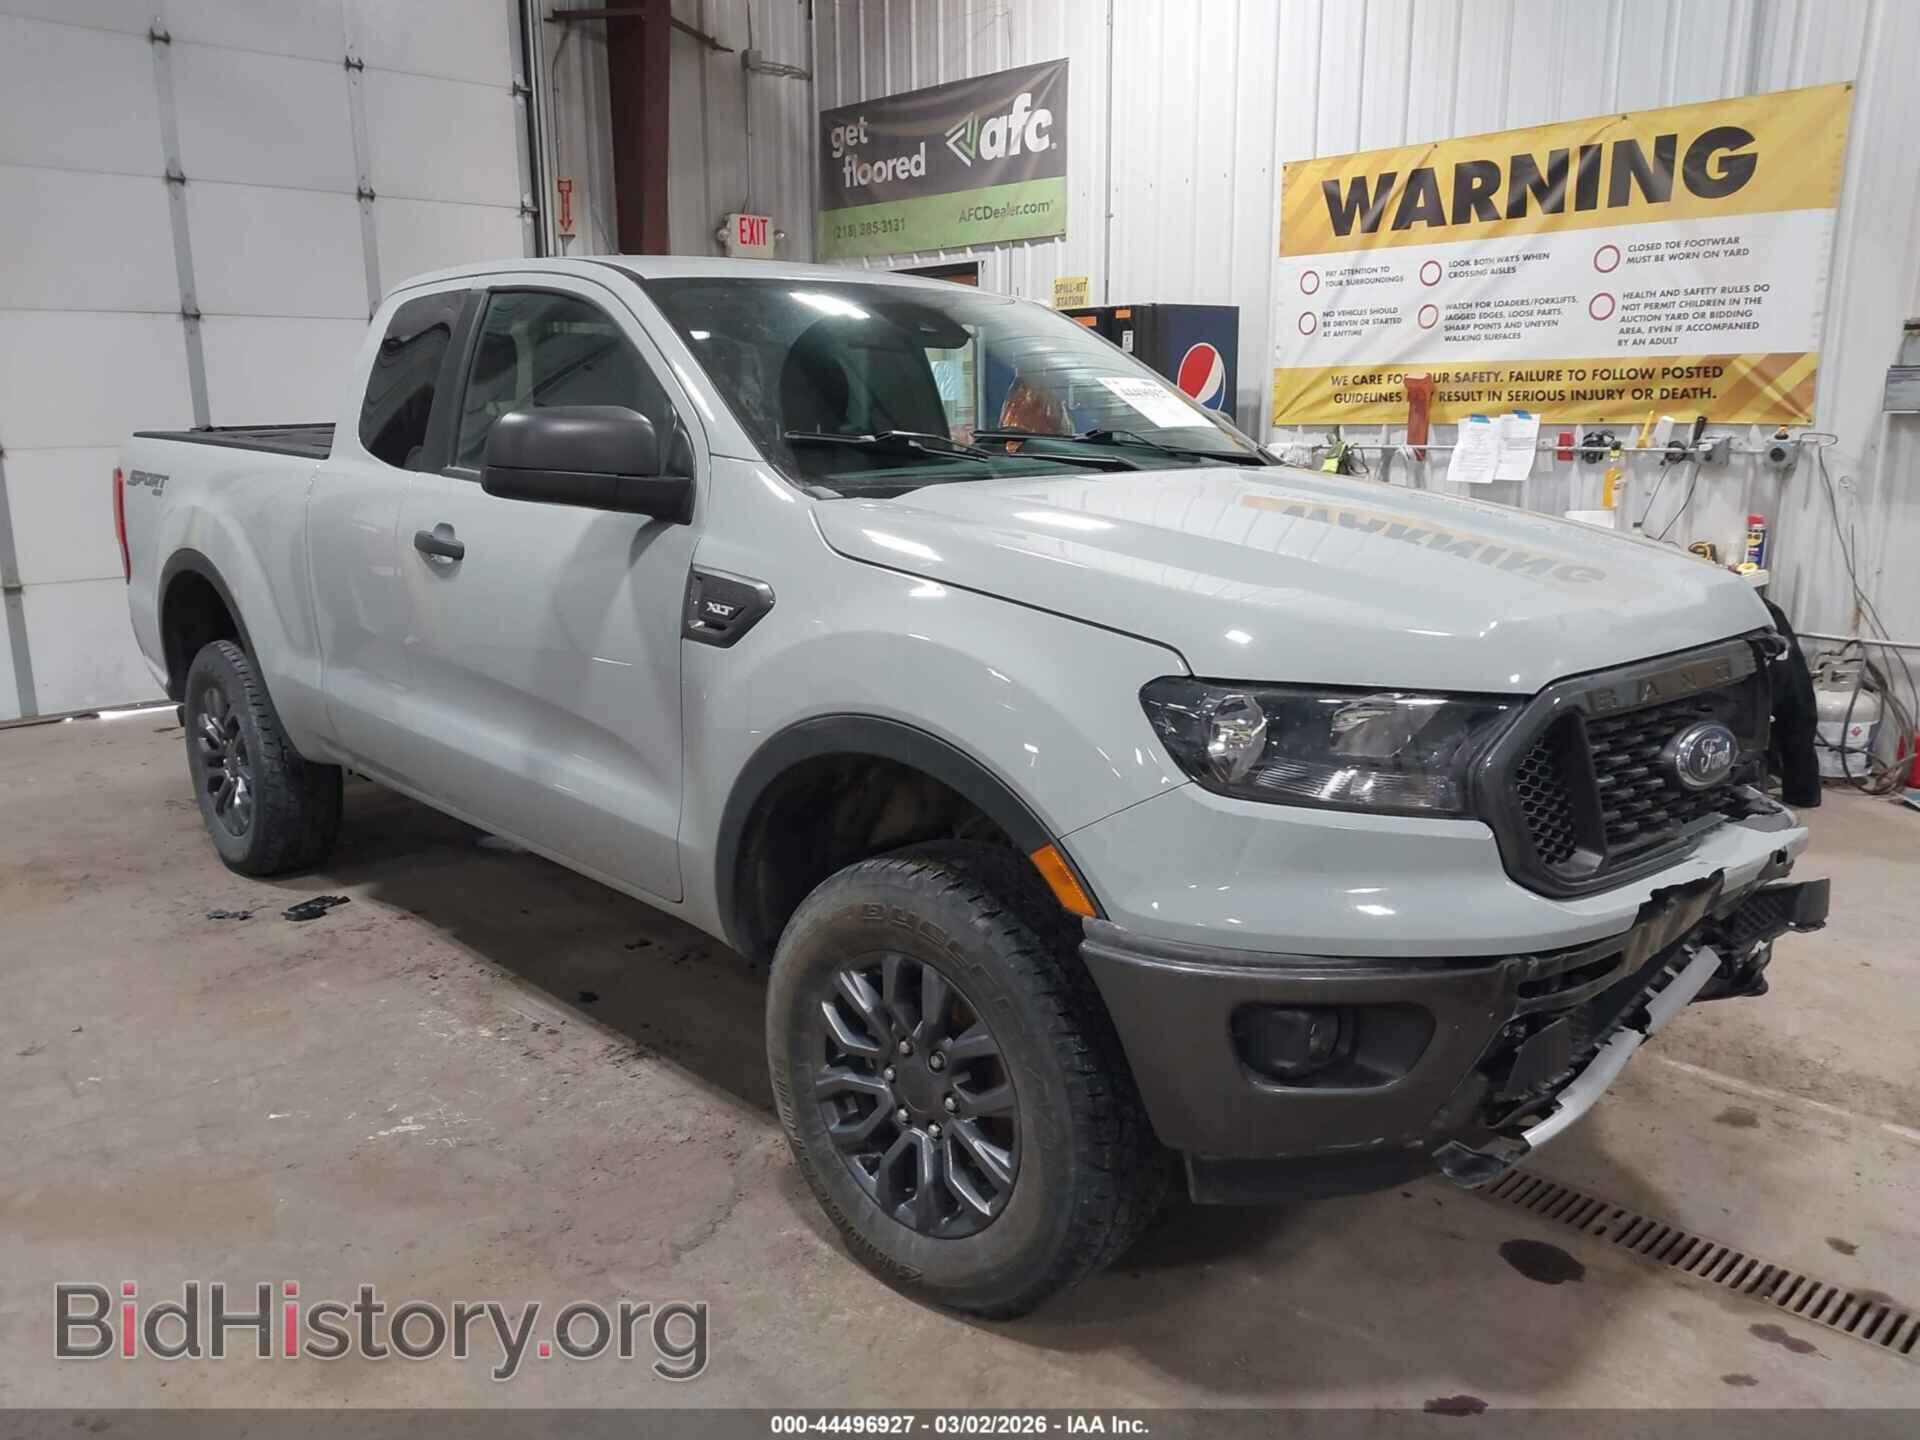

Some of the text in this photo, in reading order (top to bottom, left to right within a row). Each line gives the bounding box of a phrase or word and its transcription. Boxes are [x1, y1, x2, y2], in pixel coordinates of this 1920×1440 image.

[979, 92, 1053, 161] afc
[831, 116, 868, 158] get
[842, 141, 926, 188] floored
[1321, 126, 1758, 236] WARNING
[958, 201, 1051, 224] AFCDealer.com
[739, 217, 769, 246] EXIT
[1628, 236, 1740, 252] CLOSED TOE FOOTWEAR
[1448, 252, 1550, 268] LOOK BOTH WAYS WHEN
[1626, 248, 1749, 264] MUST BE WORN ON YARD
[1340, 267, 1378, 276] ATTENTION
[1448, 266, 1517, 279] CROSSING AISLES
[1346, 276, 1404, 287] SURROUNDINGS
[1622, 283, 1770, 300] HEALTH AND SAFETY RULES DO
[1446, 302, 1472, 310] WATCH
[1475, 301, 1491, 309] FOR
[1621, 296, 1763, 312] NOT PERMIT CHILDREN IN THE
[1323, 307, 1398, 318] NO VEHICLES SHOULD
[1445, 313, 1476, 321] JAGGED
[1508, 310, 1533, 318] LOOSE
[1620, 309, 1753, 323] AUCTION YARD OR BIDDING
[1333, 319, 1358, 328] DRIVEN
[1372, 317, 1402, 325] STARTED
[1444, 320, 1559, 332] SHARP POINTS AND UNEVEN
[1648, 325, 1672, 334] EVEN
[1675, 324, 1682, 332] IF
[1686, 322, 1760, 332] ACCOMPANIED
[1444, 332, 1521, 342] WALKING SURFACES
[1617, 337, 1678, 347] BY AN ADULT
[1331, 375, 1348, 386] WE
[1352, 373, 1382, 385] CARE
[1387, 373, 1408, 384] FO
[1455, 371, 1504, 383] SAFETY.
[1508, 369, 1563, 382] FAILURE
[1568, 369, 1586, 381] TO
[1592, 367, 1656, 381] FOLLOW
[1662, 365, 1724, 379] POSTED
[1334, 391, 1401, 404] GUIDELINES
[1439, 390, 1483, 402] RESULT
[1488, 391, 1502, 402] IN
[1507, 389, 1566, 402] SERIOUS
[1571, 388, 1625, 401] INJURY
[1631, 388, 1653, 400] OR
[1660, 386, 1717, 400] DEATH.
[706, 601, 734, 616] XLT
